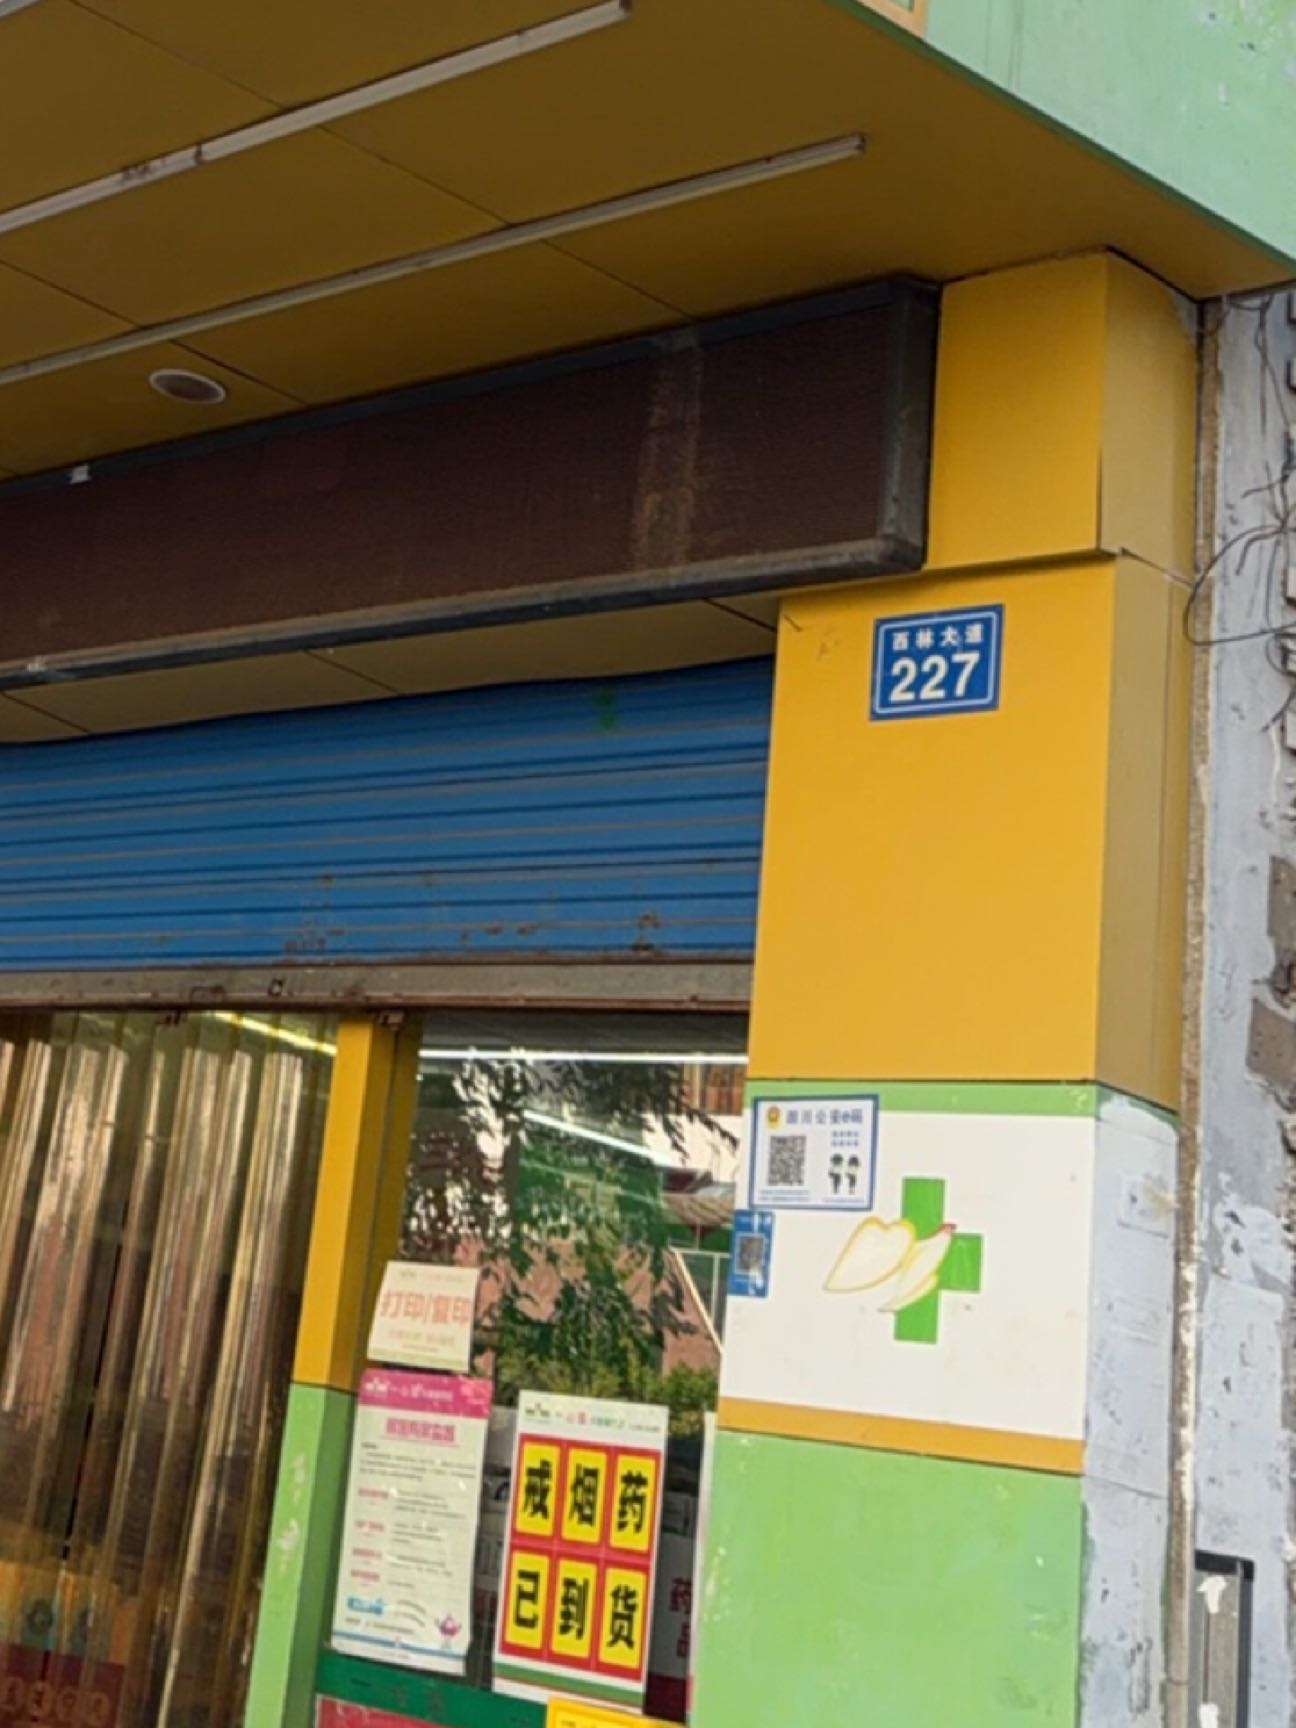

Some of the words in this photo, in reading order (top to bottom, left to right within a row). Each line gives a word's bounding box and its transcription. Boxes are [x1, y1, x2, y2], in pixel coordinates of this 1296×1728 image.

[892, 624, 984, 650] 西林大道
[890, 653, 979, 702] 227
[524, 1460, 647, 1533] 戒烟药
[514, 1570, 637, 1649] 已到货
